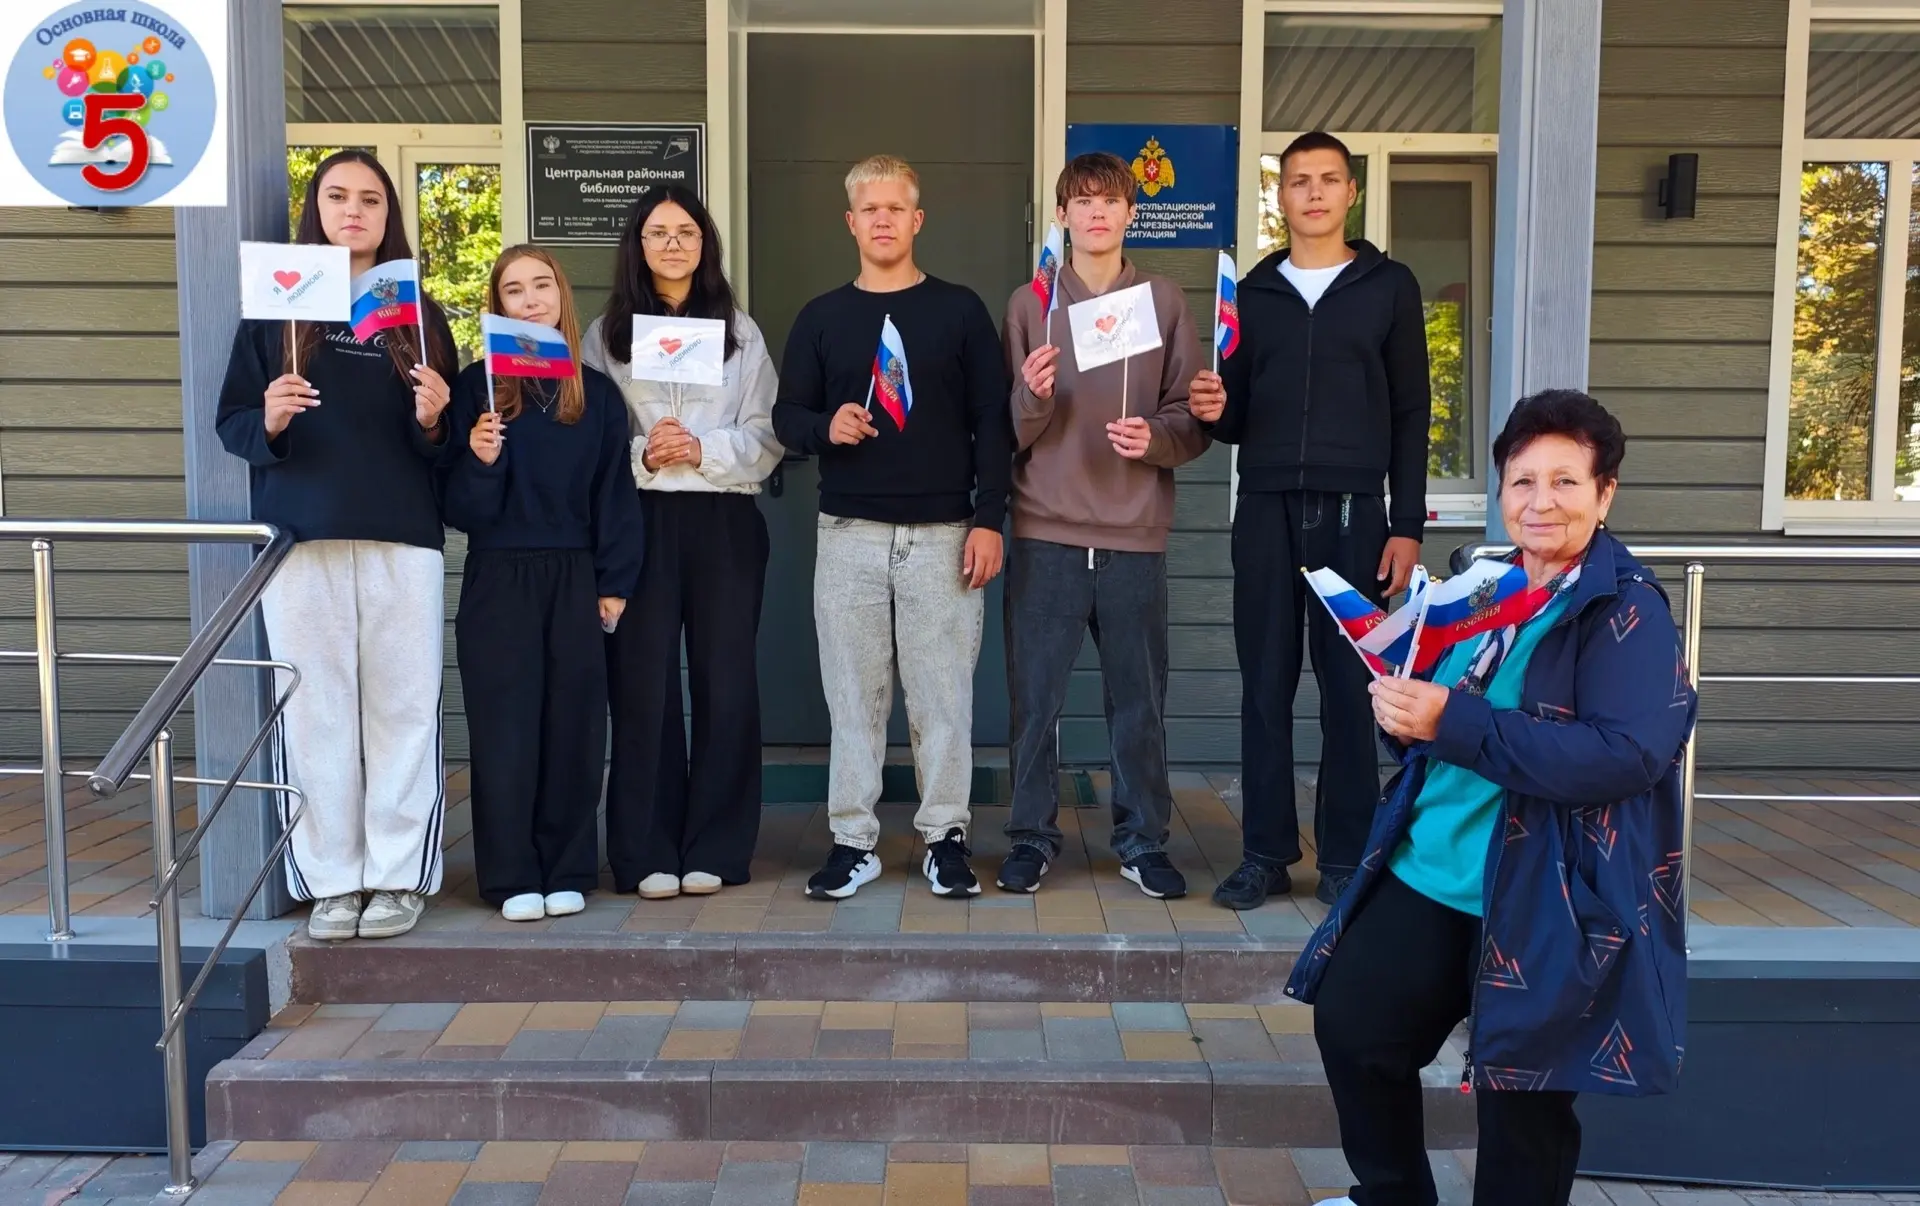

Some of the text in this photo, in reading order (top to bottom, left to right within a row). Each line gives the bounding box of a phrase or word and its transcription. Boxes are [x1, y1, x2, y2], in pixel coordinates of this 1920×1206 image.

[545, 167, 685, 181] Центральная районная
[1142, 212, 1204, 220] ГРАЖДАНСКОЙ
[1141, 221, 1213, 229] ЧРЕЗВЫЧАЙНЫМ
[1125, 231, 1177, 239] СИТУАЦИЯМ
[286, 269, 325, 304] ЛЮДИНОВО
[1455, 605, 1501, 632] РОССИЯ
